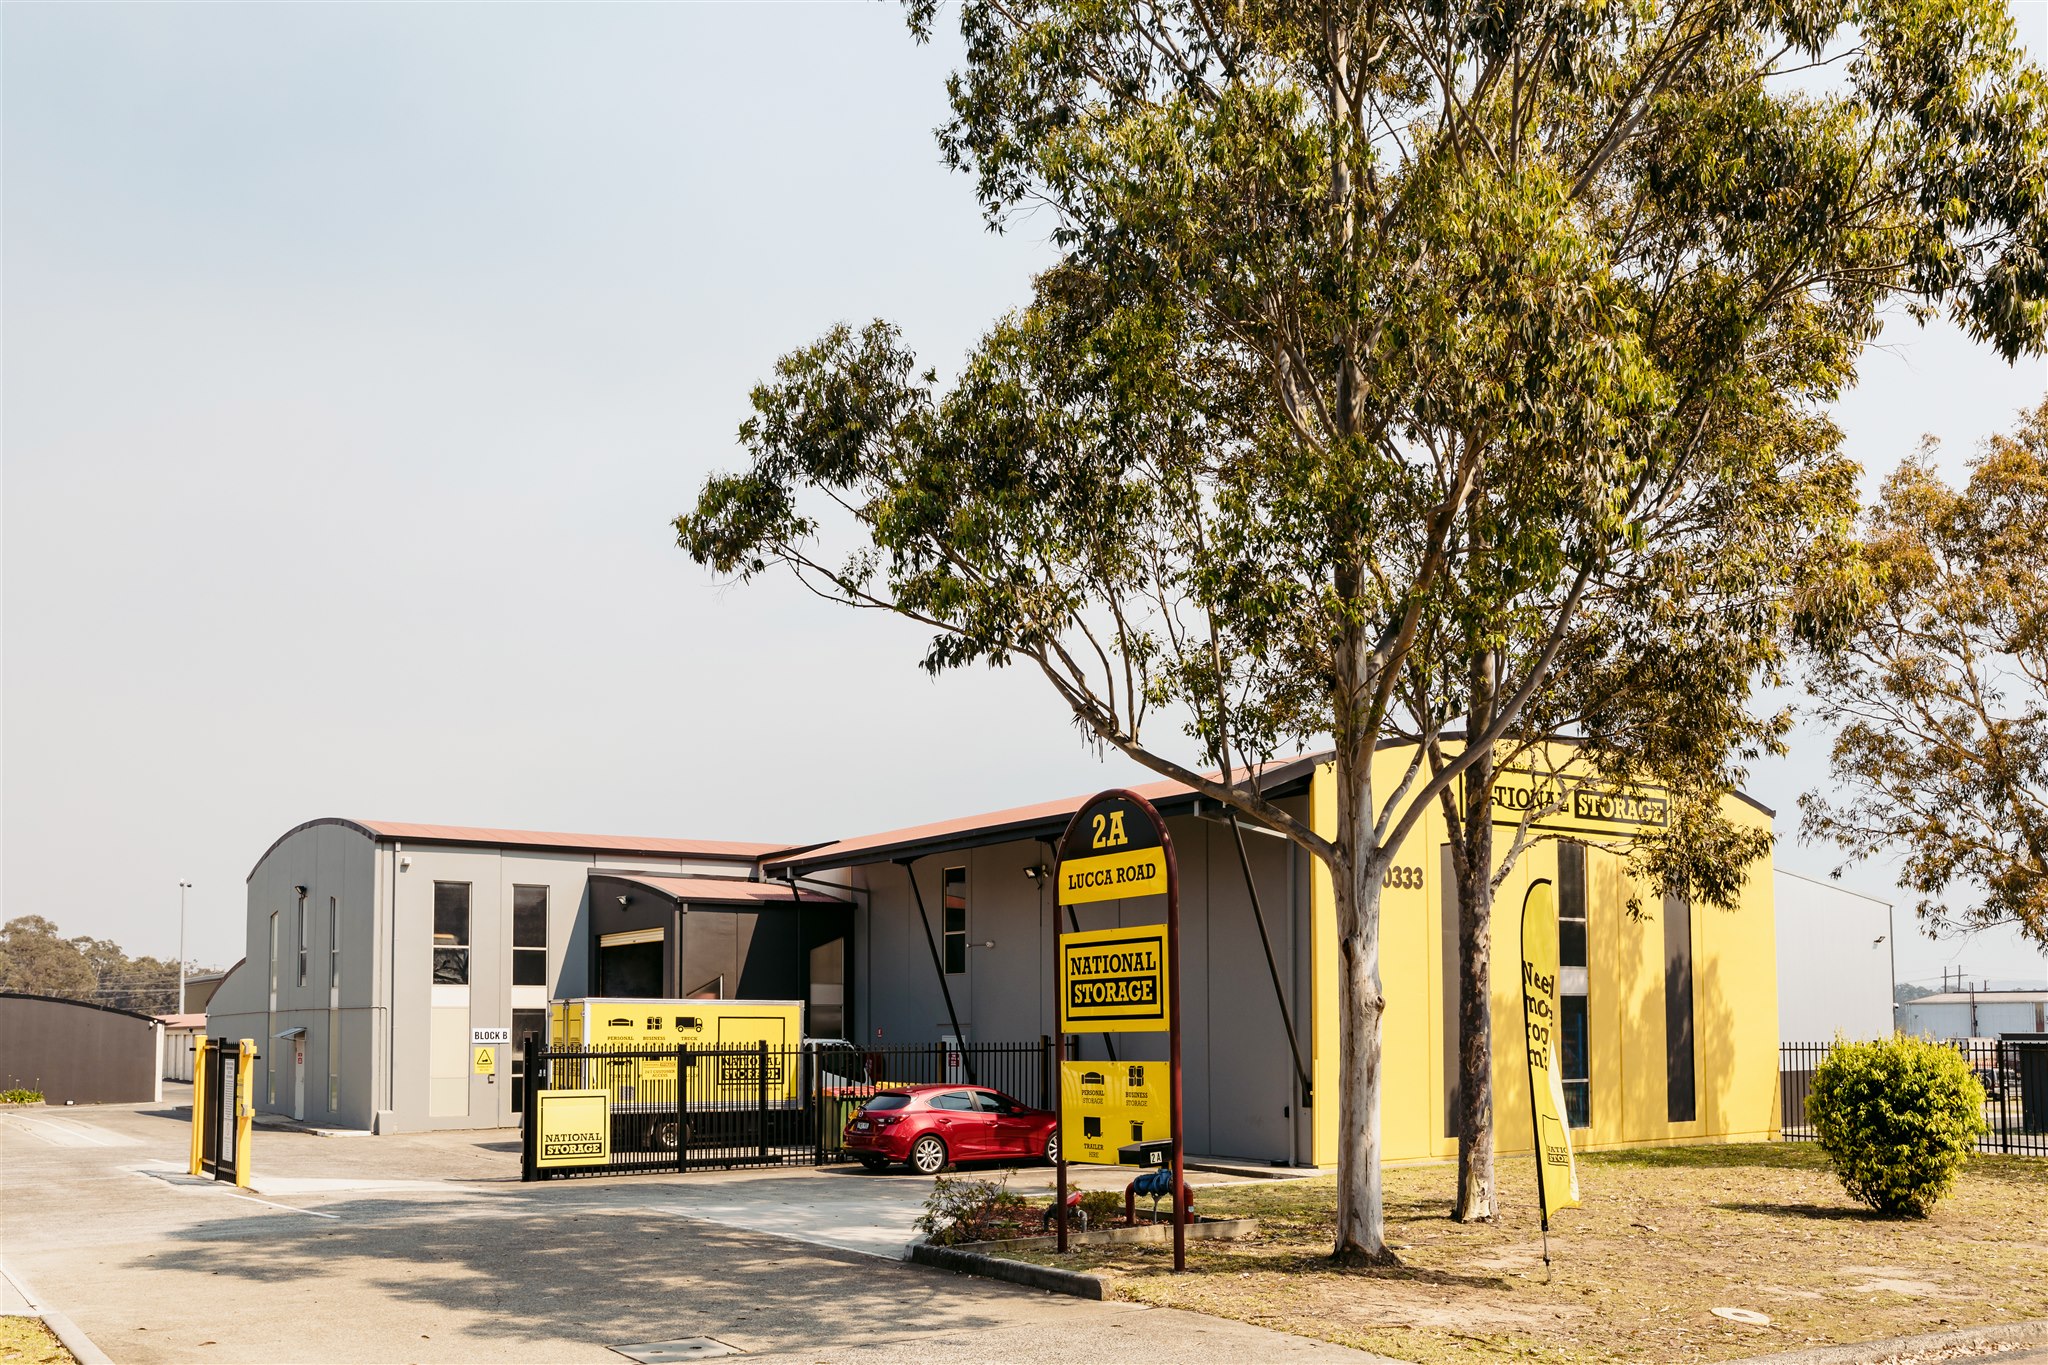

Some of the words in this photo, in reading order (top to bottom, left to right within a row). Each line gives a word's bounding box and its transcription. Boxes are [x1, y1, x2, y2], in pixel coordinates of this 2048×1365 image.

[1491, 785, 1570, 813] TIONAL
[1578, 794, 1665, 824] STORAGE
[1092, 810, 1129, 849] 2A
[1068, 869, 1114, 890] LUCCA
[1116, 863, 1156, 883] ROAD
[1382, 865, 1424, 890] 0333
[1070, 951, 1157, 976] NATIONAL
[1074, 980, 1153, 1004] STORAGE
[474, 1031, 500, 1040] BLOCK
[502, 1031, 508, 1040] B
[721, 1057, 781, 1066] NATIOAL
[1125, 1091, 1148, 1099] BUSINESS
[545, 1133, 602, 1142] NATIONAL
[547, 1143, 600, 1155] STORAGE
